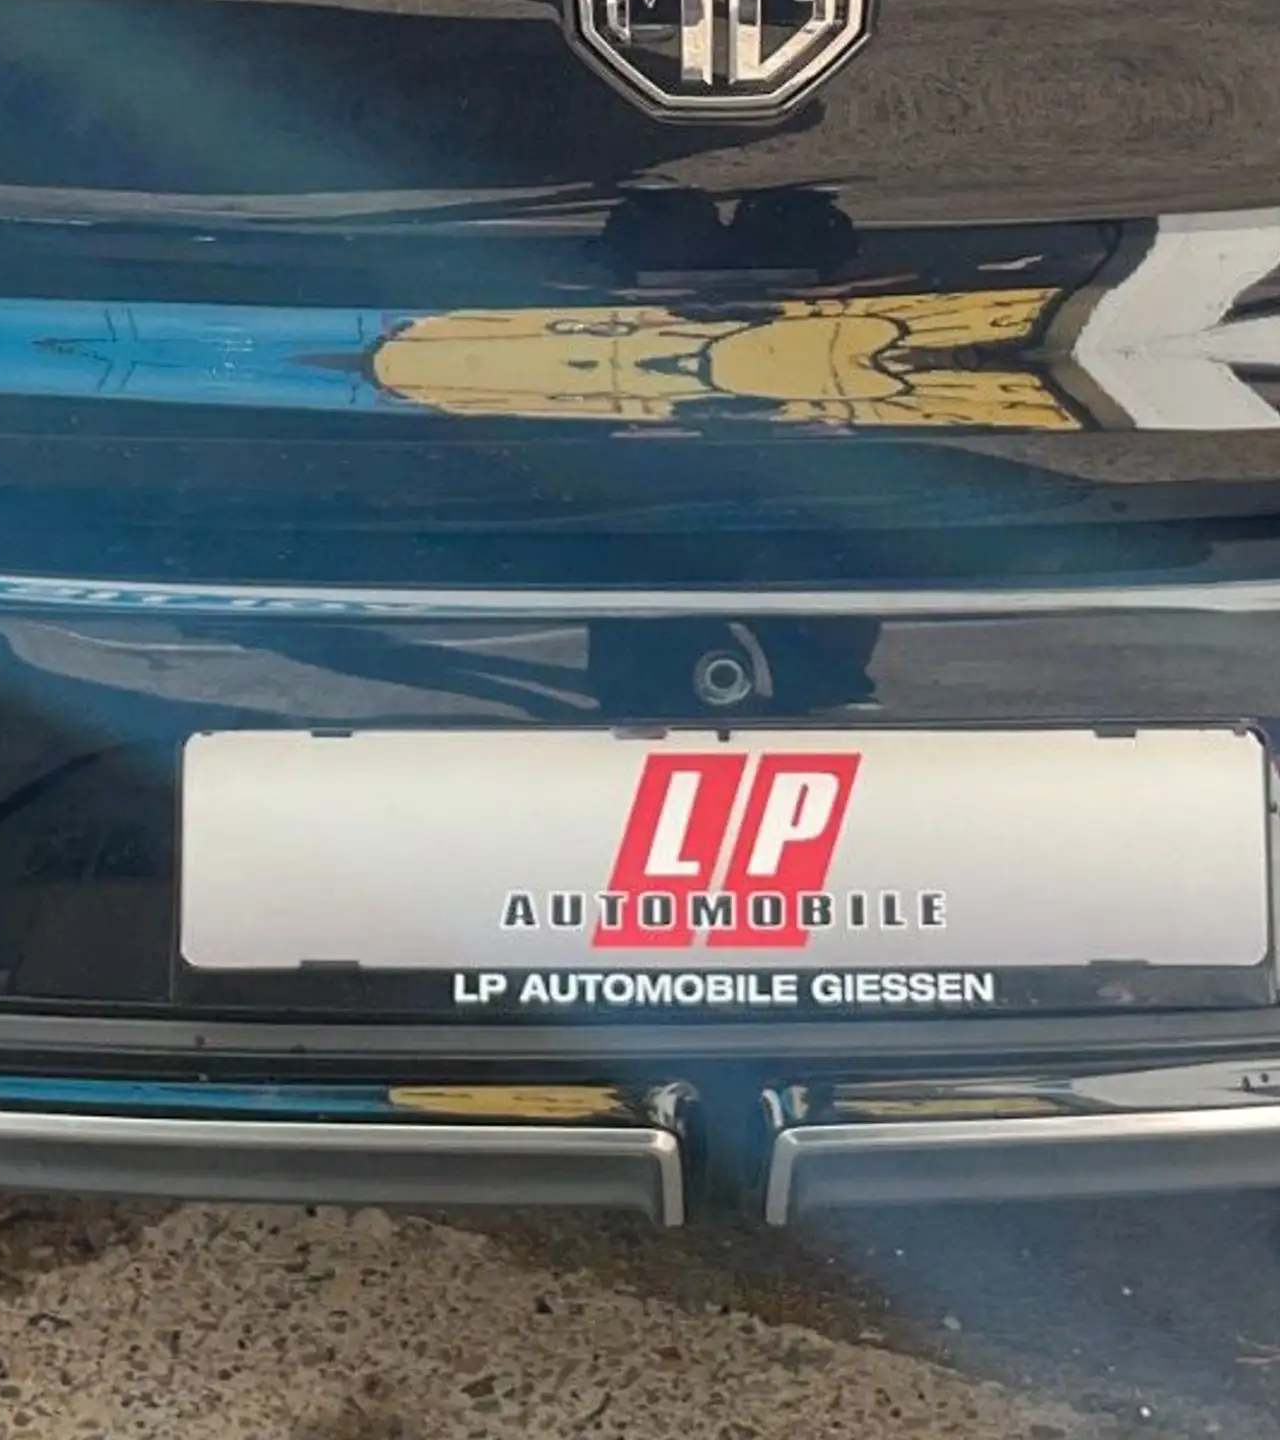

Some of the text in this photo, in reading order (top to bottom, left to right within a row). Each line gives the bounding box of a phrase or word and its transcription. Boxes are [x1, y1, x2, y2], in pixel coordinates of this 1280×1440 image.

[644, 770, 840, 876] LP
[502, 892, 947, 929] AUTOMOBILE
[453, 973, 995, 1004] LP AUTOMOBILE GIESSEN
